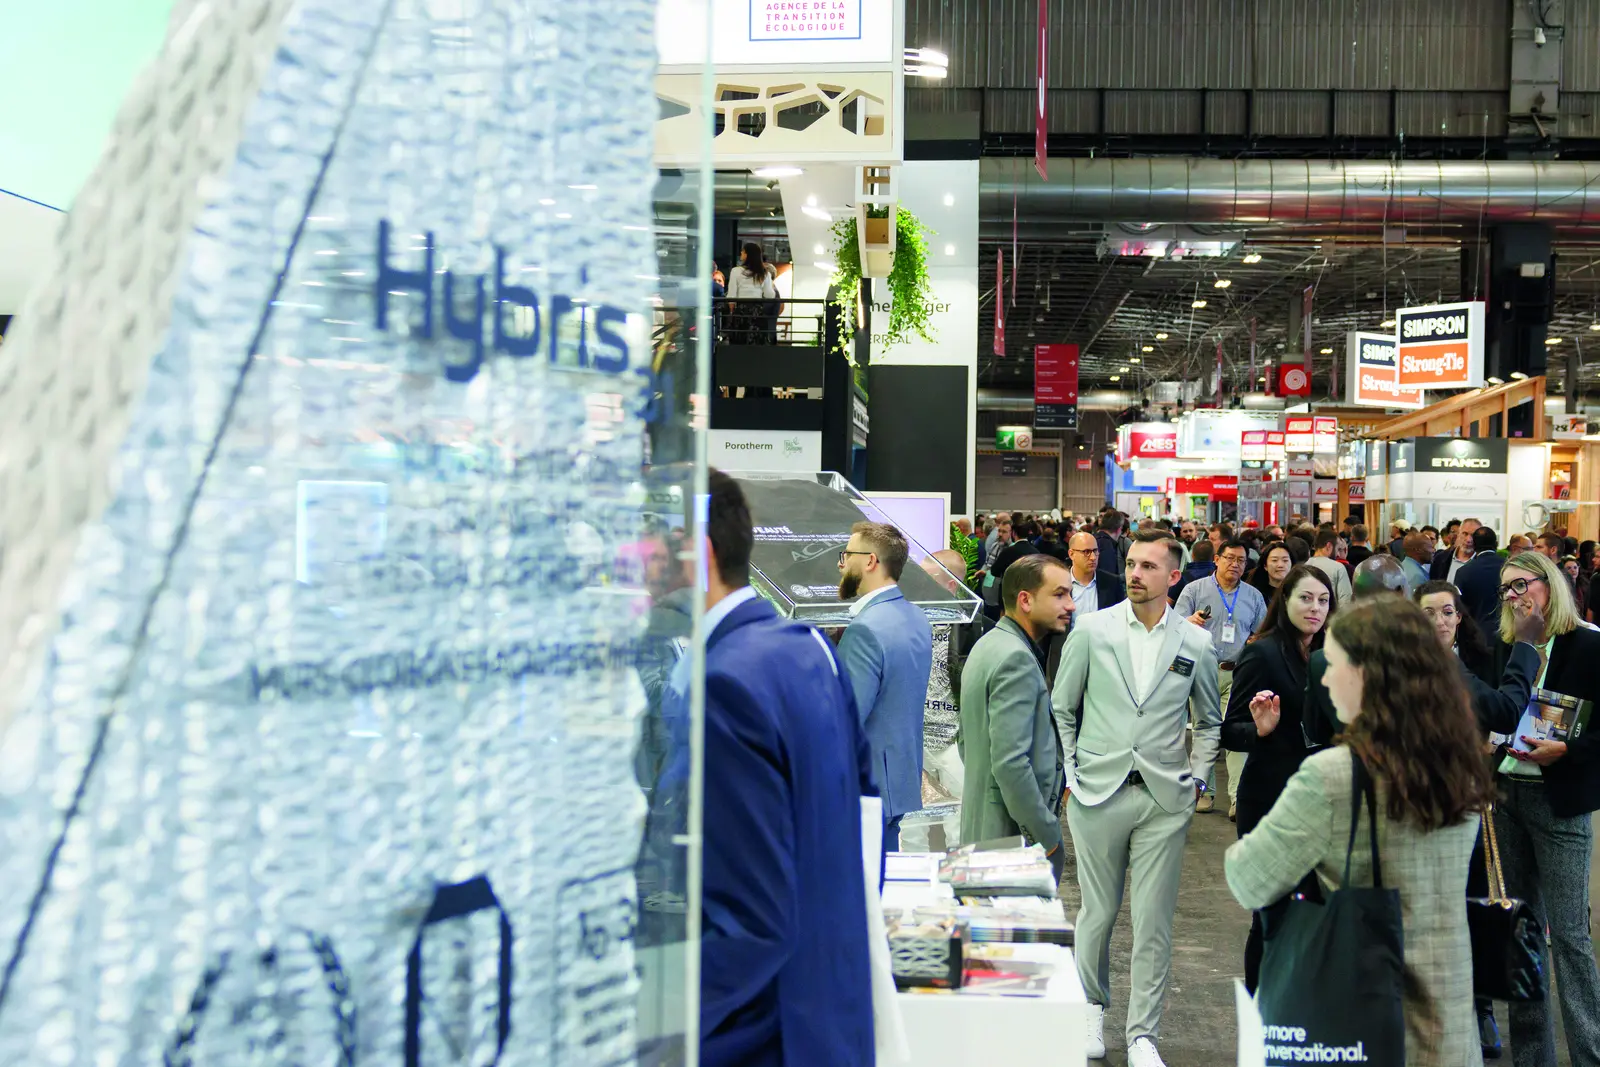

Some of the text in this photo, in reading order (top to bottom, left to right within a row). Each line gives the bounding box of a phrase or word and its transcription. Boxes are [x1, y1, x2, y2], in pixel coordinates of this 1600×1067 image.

[766, 1, 845, 11] AGENCE DE LA
[766, 13, 845, 21] TRANSITION
[765, 22, 845, 32] ÉCOLOGIQUE
[375, 217, 631, 384] Hybris
[1403, 314, 1466, 338] SIMPSON
[1362, 343, 1396, 362] SIMP
[1402, 352, 1465, 377] Strong-Tie
[724, 441, 774, 451] Porotherm
[1431, 457, 1491, 468] ETANCO
[1268, 1025, 1307, 1042] more
